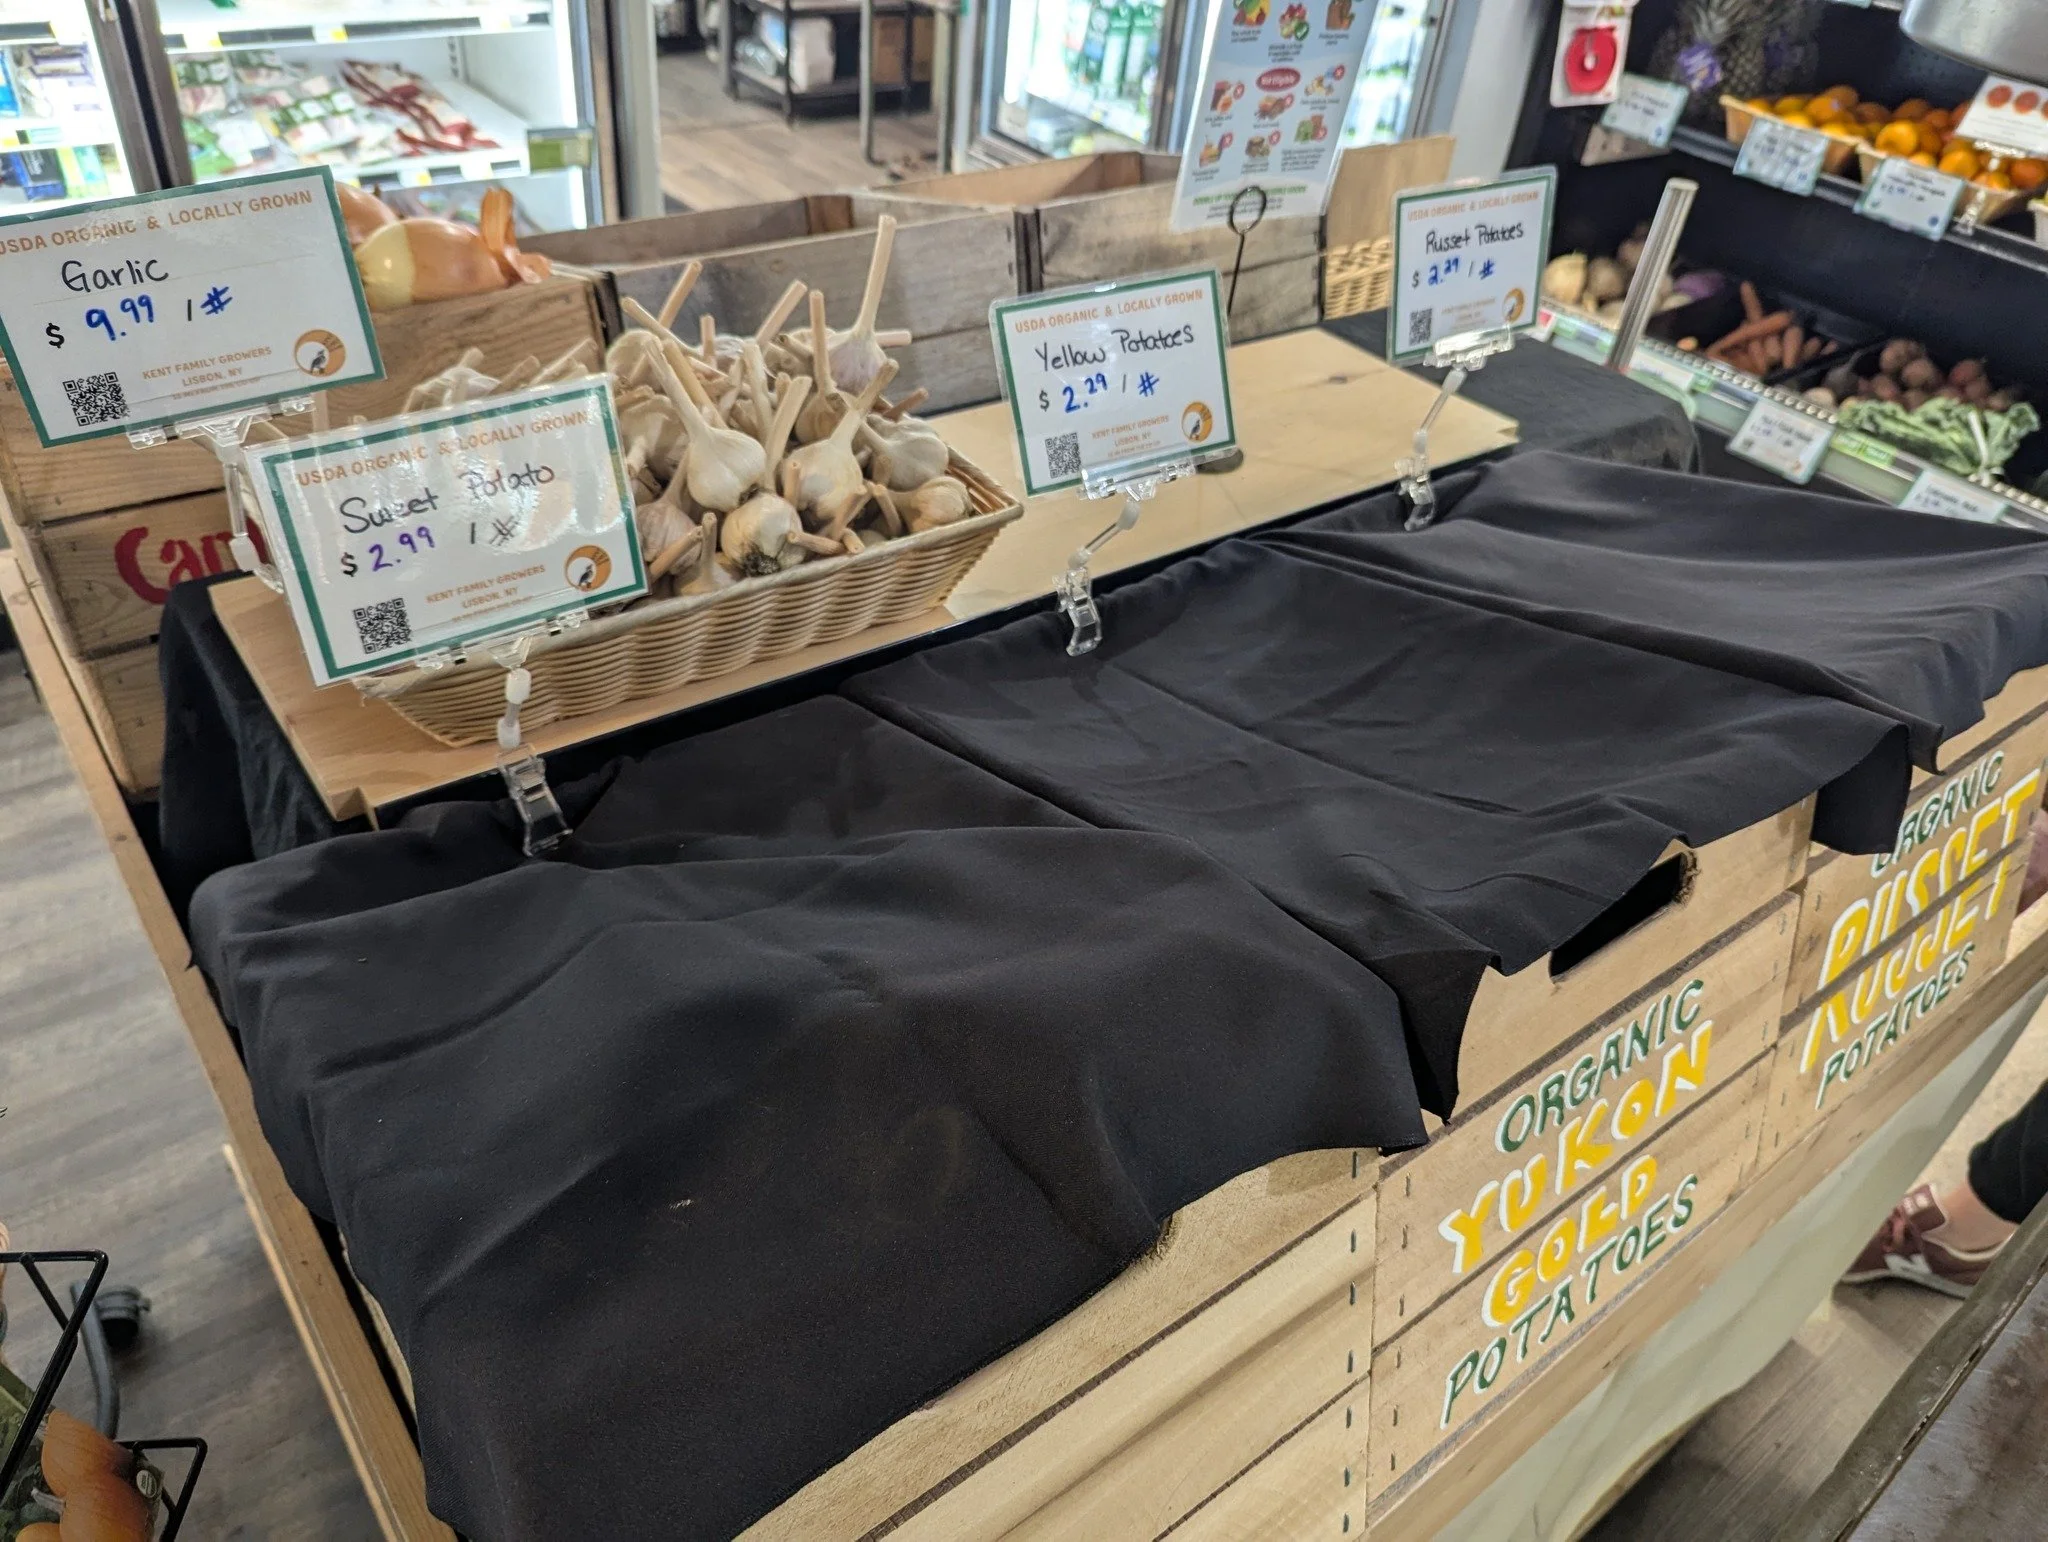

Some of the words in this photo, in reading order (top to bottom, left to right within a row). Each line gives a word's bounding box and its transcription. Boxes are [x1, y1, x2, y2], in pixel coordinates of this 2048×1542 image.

[52, 219, 137, 246] ORGANIC
[147, 216, 160, 229] &
[170, 202, 244, 226] LOCALLY
[249, 190, 313, 212] GROWN
[1425, 229, 1470, 254] Russet
[1475, 222, 1525, 246] Potatoes
[61, 258, 169, 292] Garlic
[46, 322, 65, 349] $
[85, 294, 155, 341] 9.99
[200, 286, 233, 316] #
[1015, 320, 1047, 333] USDA
[1048, 308, 1099, 326] ORGANIC
[1104, 305, 1113, 317] &
[1117, 298, 1163, 314] LOCALLY
[1164, 289, 1203, 306] GROWN
[142, 366, 172, 380] KENT
[175, 357, 216, 373] FAMILY
[219, 346, 273, 365] GROWERS
[228, 367, 243, 378] NY
[1035, 342, 1107, 372] Yellow
[1111, 324, 1195, 354] Potatoes
[1039, 390, 1050, 412] $
[1062, 373, 1108, 413] 2.29
[1137, 371, 1160, 398] #
[299, 467, 348, 487] USDA
[352, 445, 426, 475] ORGANIC
[438, 441, 451, 455] &
[457, 424, 526, 451] LOCALLY
[530, 411, 588, 434] GROWN
[340, 494, 439, 533] Sweet
[457, 463, 556, 498] Potato
[340, 552, 358, 577] $
[369, 526, 435, 572] 2.99
[457, 579, 494, 595] FAMILY
[496, 564, 545, 584] GROWERS
[1799, 767, 2040, 1074] RUSSET
[1815, 942, 1975, 1111] POTATOES
[1495, 979, 1704, 1153] ORGANIC
[1438, 1019, 1713, 1274] YUKON
[1481, 1154, 1658, 1328] GOLD
[1440, 1173, 1698, 1430] POTATOES
